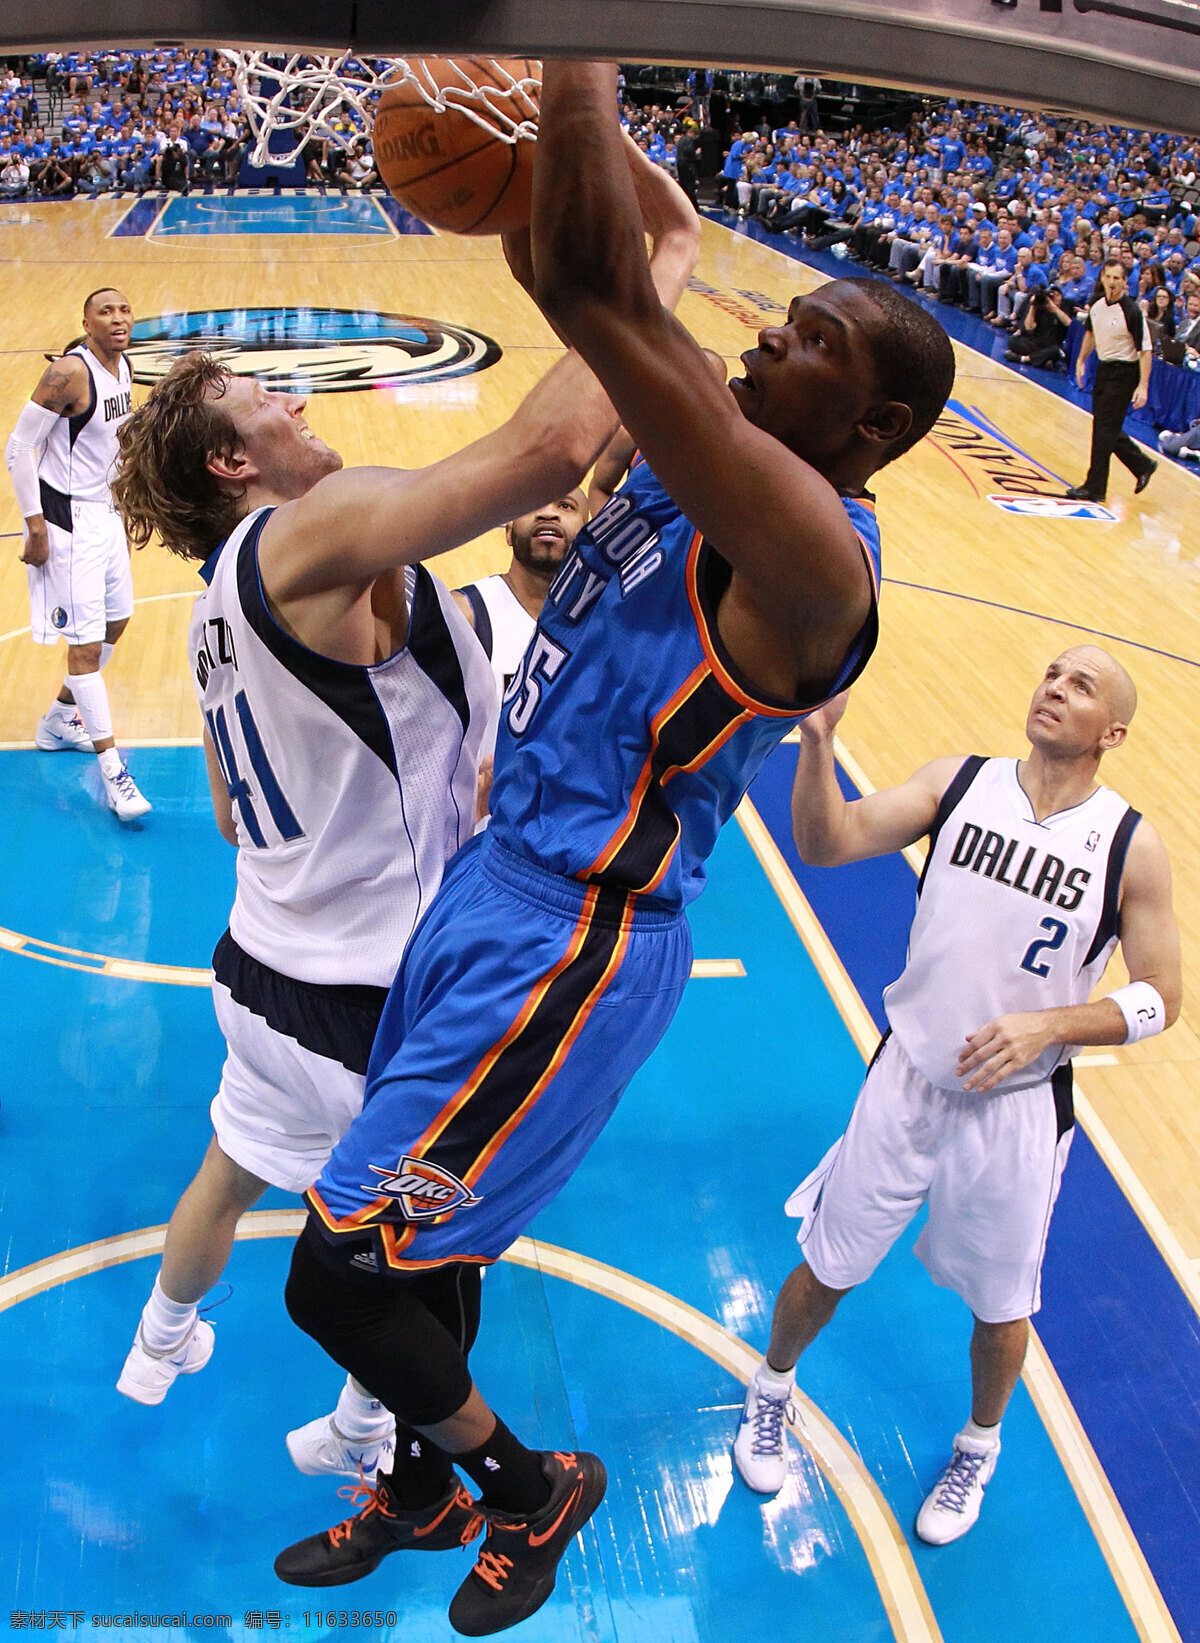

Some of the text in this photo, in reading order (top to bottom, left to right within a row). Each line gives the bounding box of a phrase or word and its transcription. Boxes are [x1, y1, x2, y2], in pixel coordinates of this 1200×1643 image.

[103, 391, 132, 422] DALLA
[549, 545, 607, 619] ITY
[206, 688, 307, 849] 41
[949, 822, 1093, 912] DALLAS
[1017, 915, 1070, 979] 2
[383, 1173, 457, 1200] OKC
